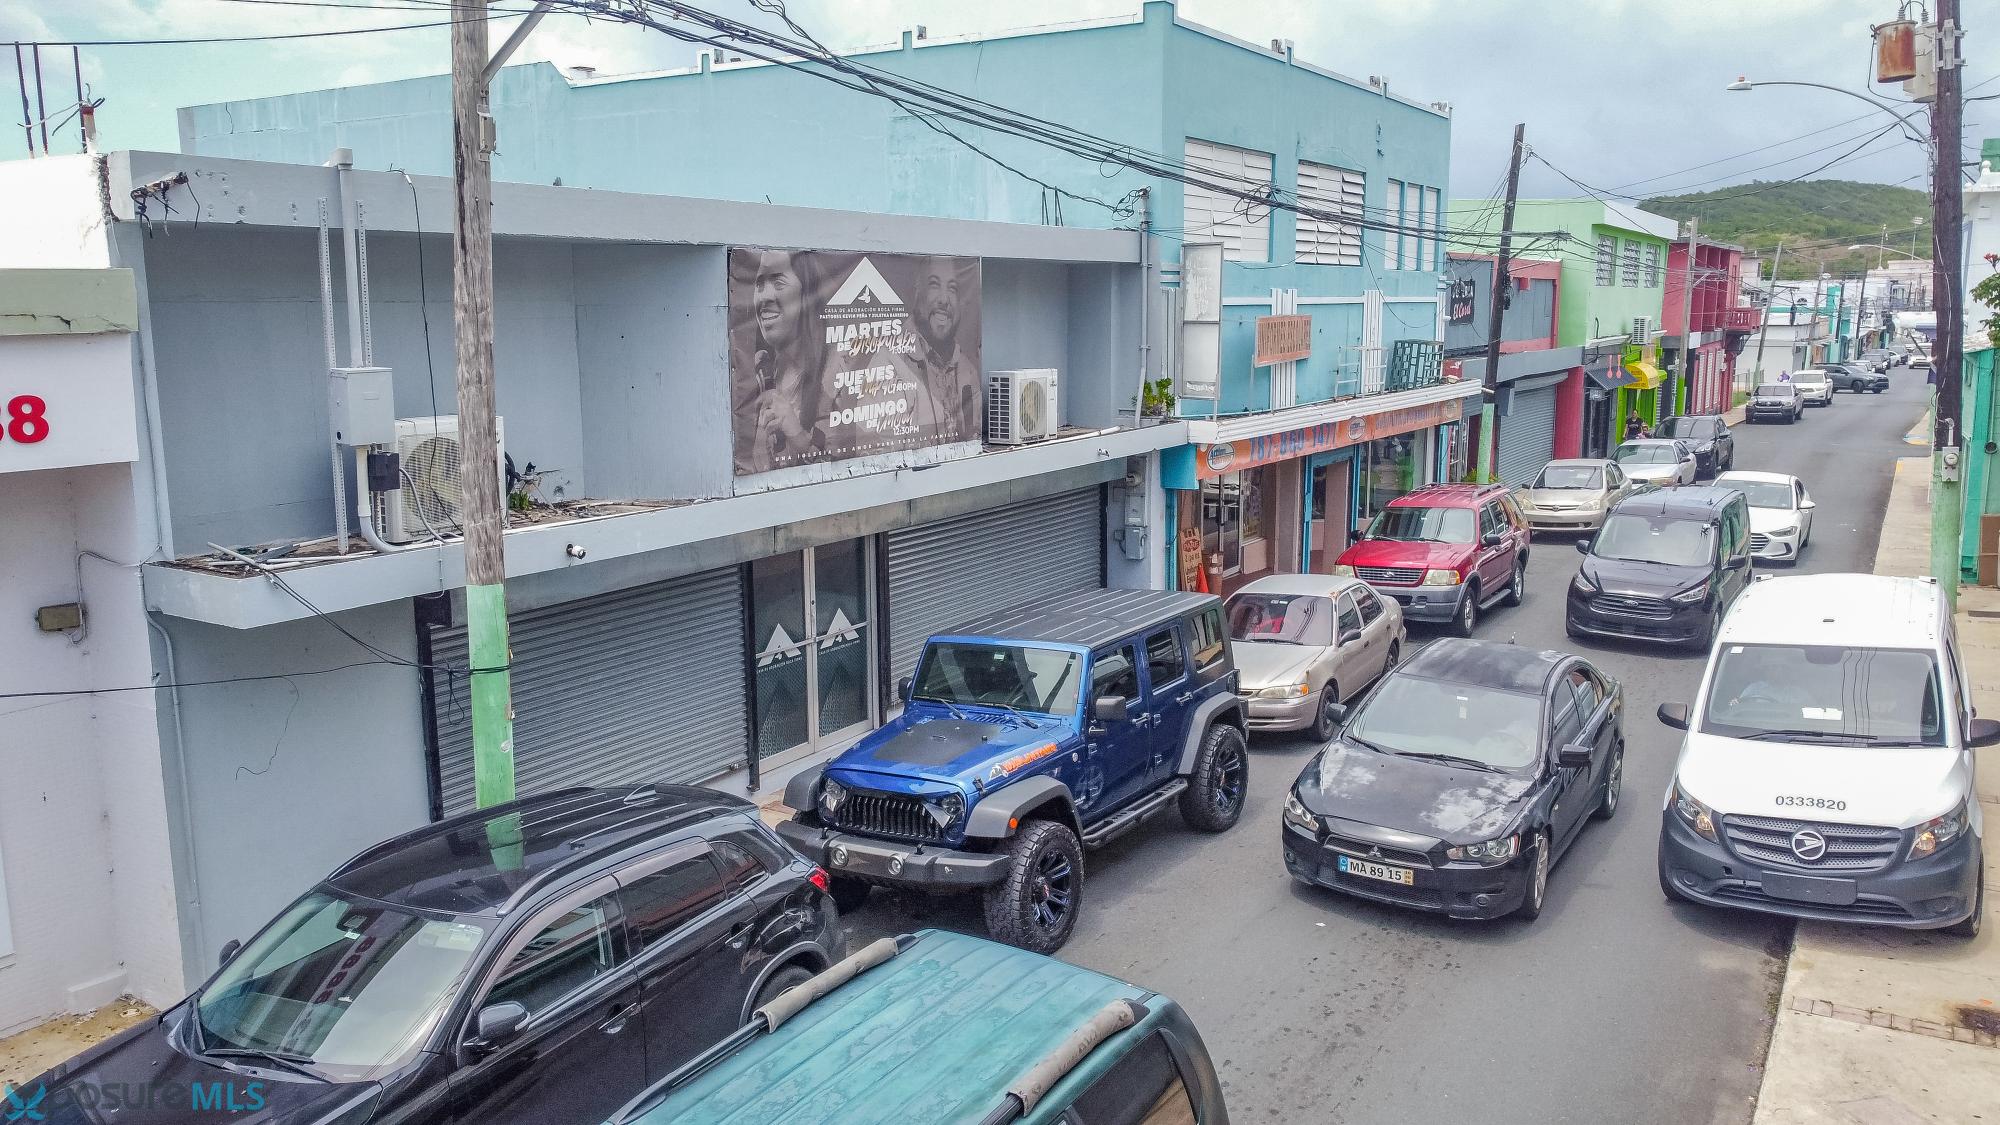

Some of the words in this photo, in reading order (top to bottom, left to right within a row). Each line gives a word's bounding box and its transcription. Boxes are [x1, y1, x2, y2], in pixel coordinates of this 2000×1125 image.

[825, 319, 902, 343] MARTES
[837, 341, 852, 352] DE
[833, 364, 895, 389] JUEVES
[848, 384, 862, 395] DE
[0, 394, 50, 444] 8
[829, 398, 907, 428] DOMINGO
[866, 419, 878, 429] DE
[893, 425, 920, 436] 12:30PM
[1775, 795, 1846, 811] 0333820
[1350, 861, 1367, 874] MA
[1369, 866, 1384, 877] 89
[1387, 869, 1402, 881] 15
